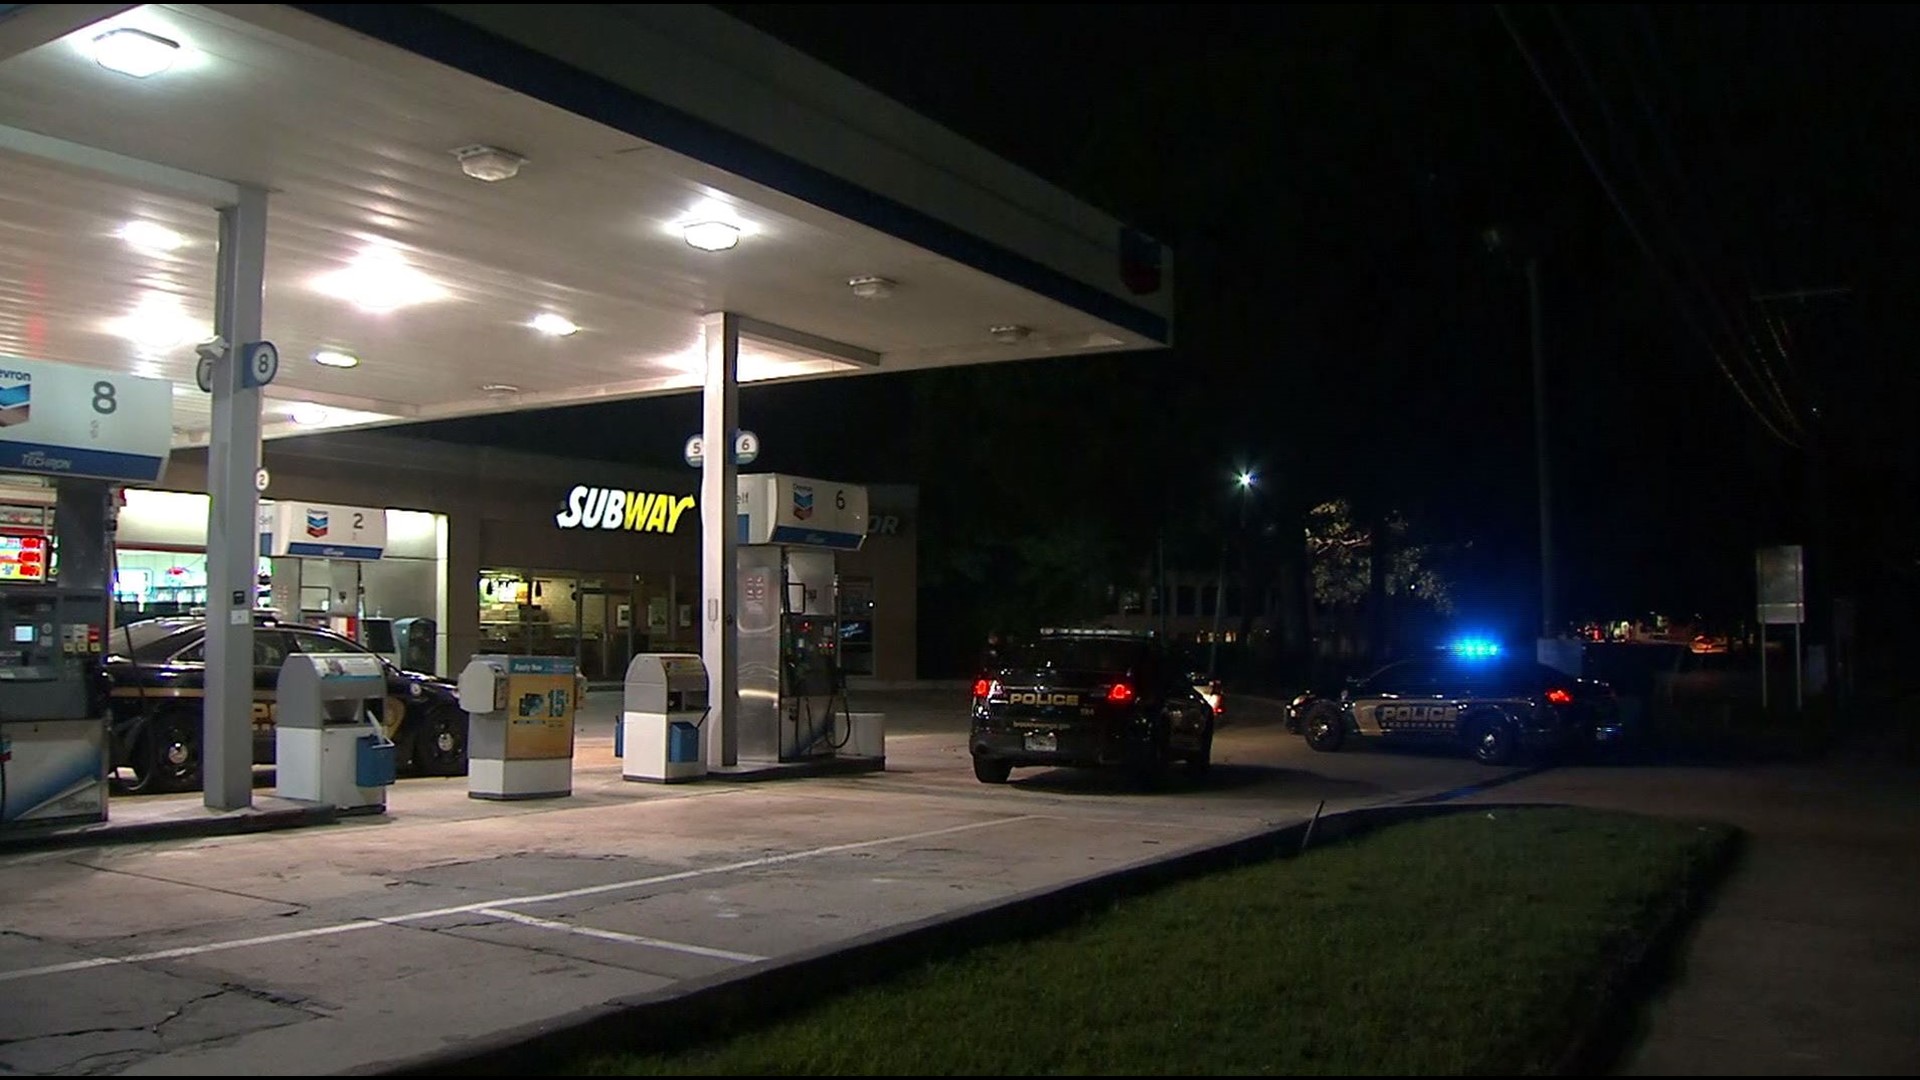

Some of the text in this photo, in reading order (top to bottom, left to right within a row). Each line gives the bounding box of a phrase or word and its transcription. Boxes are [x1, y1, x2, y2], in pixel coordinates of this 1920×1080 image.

[259, 353, 269, 374] 8
[92, 380, 117, 415] 8
[693, 442, 702, 455] 5
[741, 438, 750, 451] 6
[260, 474, 266, 486] 2
[836, 490, 846, 510] 6
[556, 484, 696, 535] SUBWAY
[353, 513, 363, 530] 2
[1010, 693, 1079, 706] POLICE
[1382, 706, 1458, 721] POLICE
